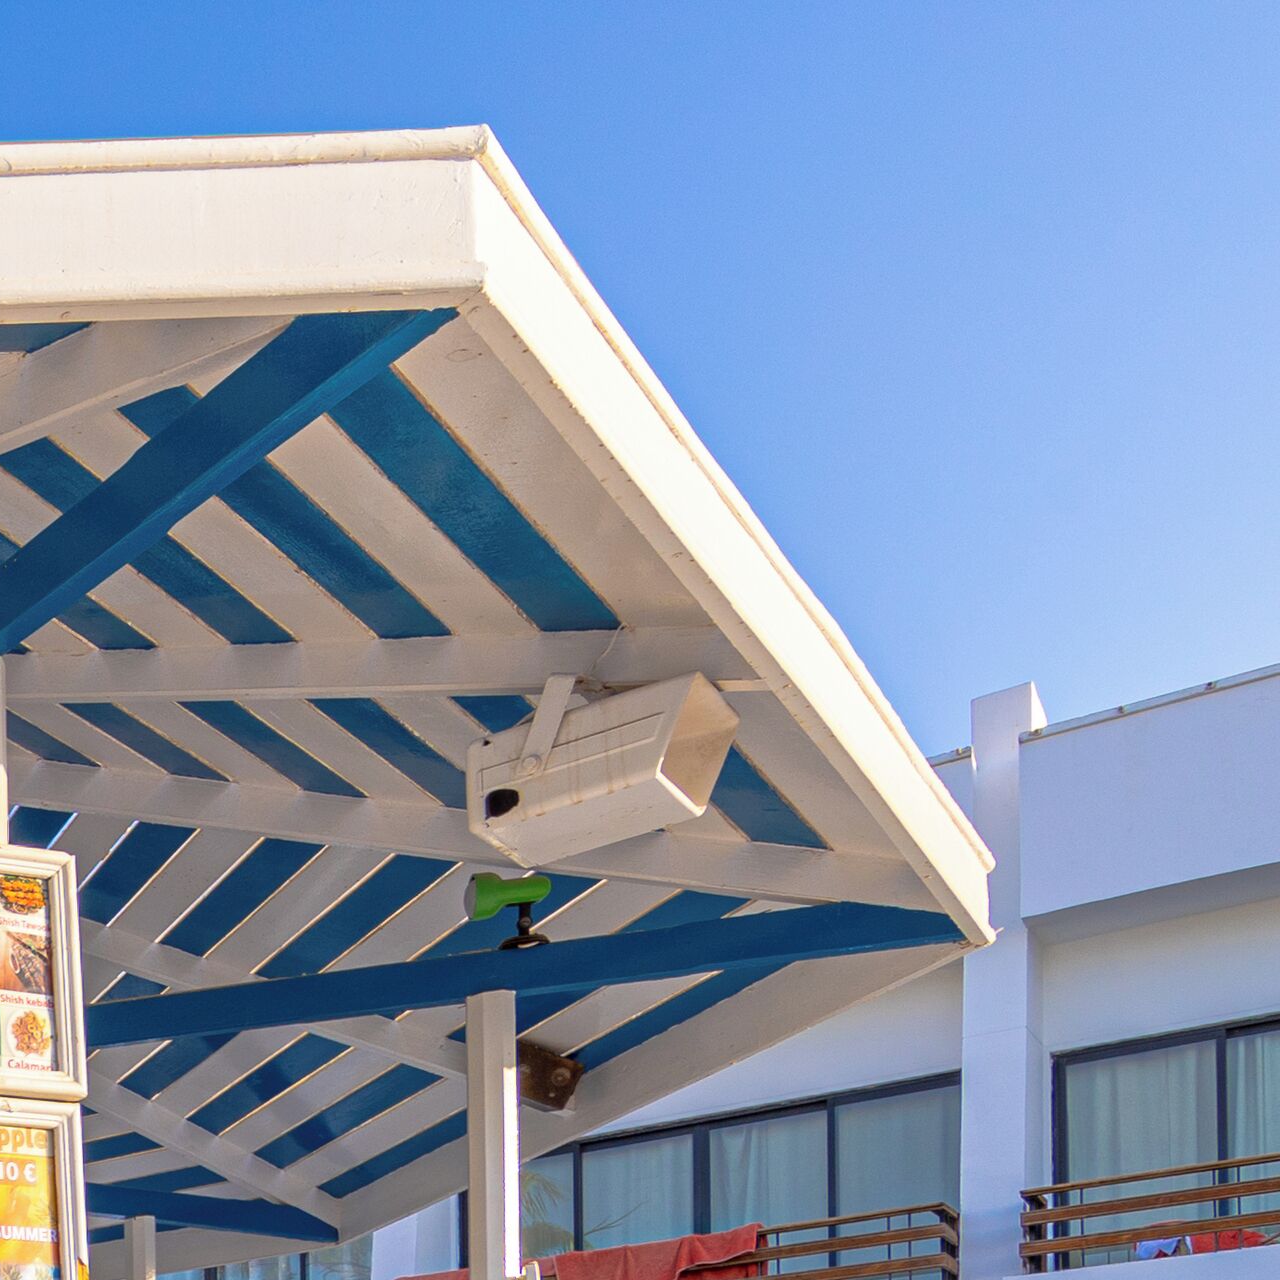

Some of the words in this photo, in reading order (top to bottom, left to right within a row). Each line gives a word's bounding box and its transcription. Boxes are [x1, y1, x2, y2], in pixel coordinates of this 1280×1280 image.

[0, 993, 25, 1005] Shish
[26, 996, 54, 1009] kebab
[23, 1161, 38, 1183] €
